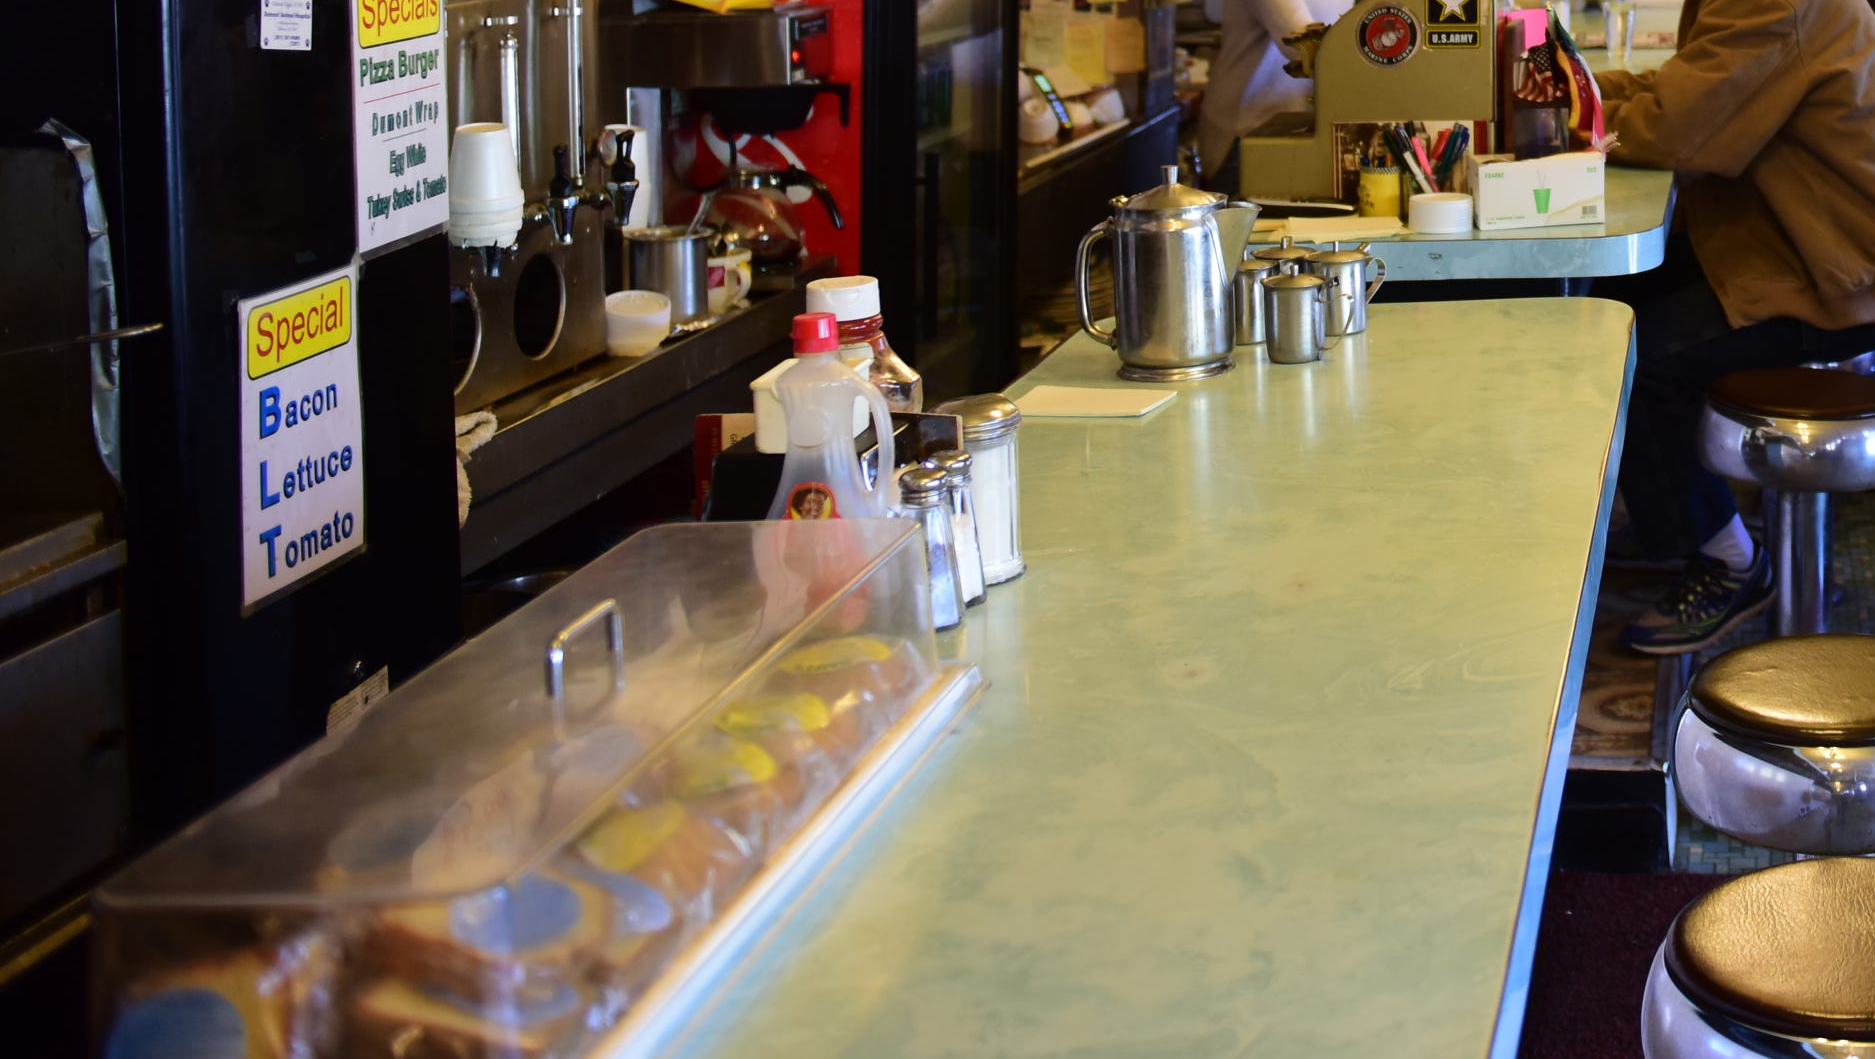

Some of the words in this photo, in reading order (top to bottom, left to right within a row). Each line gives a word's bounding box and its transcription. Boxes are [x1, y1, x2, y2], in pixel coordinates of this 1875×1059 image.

[1364, 8, 1387, 24] UNITED
[1390, 8, 1411, 24] STATES
[359, 57, 395, 88] Pizza
[398, 49, 440, 79] Burger
[1363, 45, 1388, 64] MARINE
[1391, 45, 1414, 63] CORPS
[371, 108, 414, 138] Dumont
[414, 99, 440, 125] Wrap
[389, 149, 406, 178] Egg
[405, 142, 427, 167] White
[366, 193, 392, 220] Turkey
[422, 173, 447, 200] Tomato
[256, 285, 345, 364] Special
[259, 382, 338, 441] Bacon
[260, 444, 353, 512] Lettuce
[259, 509, 355, 579] Tomato
